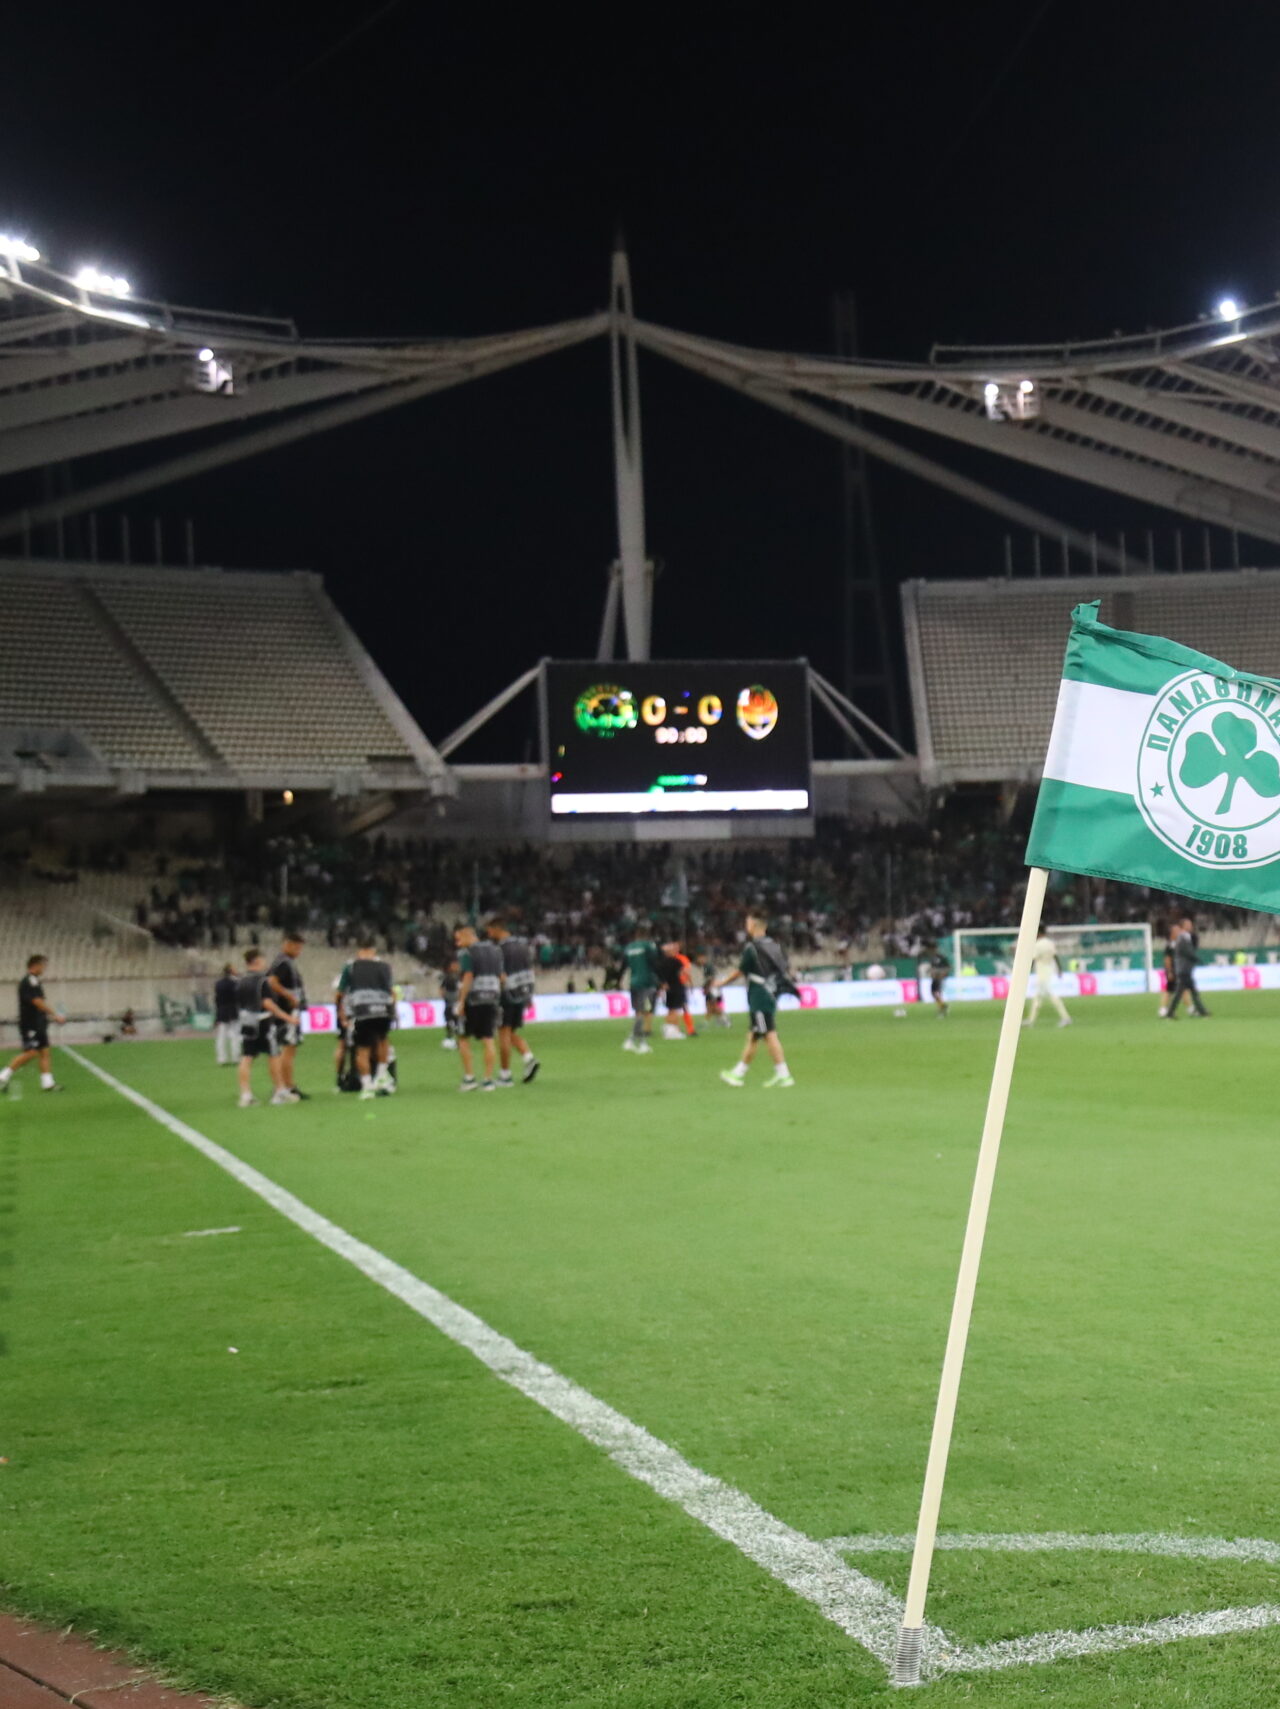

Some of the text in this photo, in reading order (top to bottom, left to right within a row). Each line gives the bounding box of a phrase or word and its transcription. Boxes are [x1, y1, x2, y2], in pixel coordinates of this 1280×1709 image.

[642, 695, 667, 726] 0
[698, 695, 723, 726] 0
[1185, 824, 1248, 859] 1908
